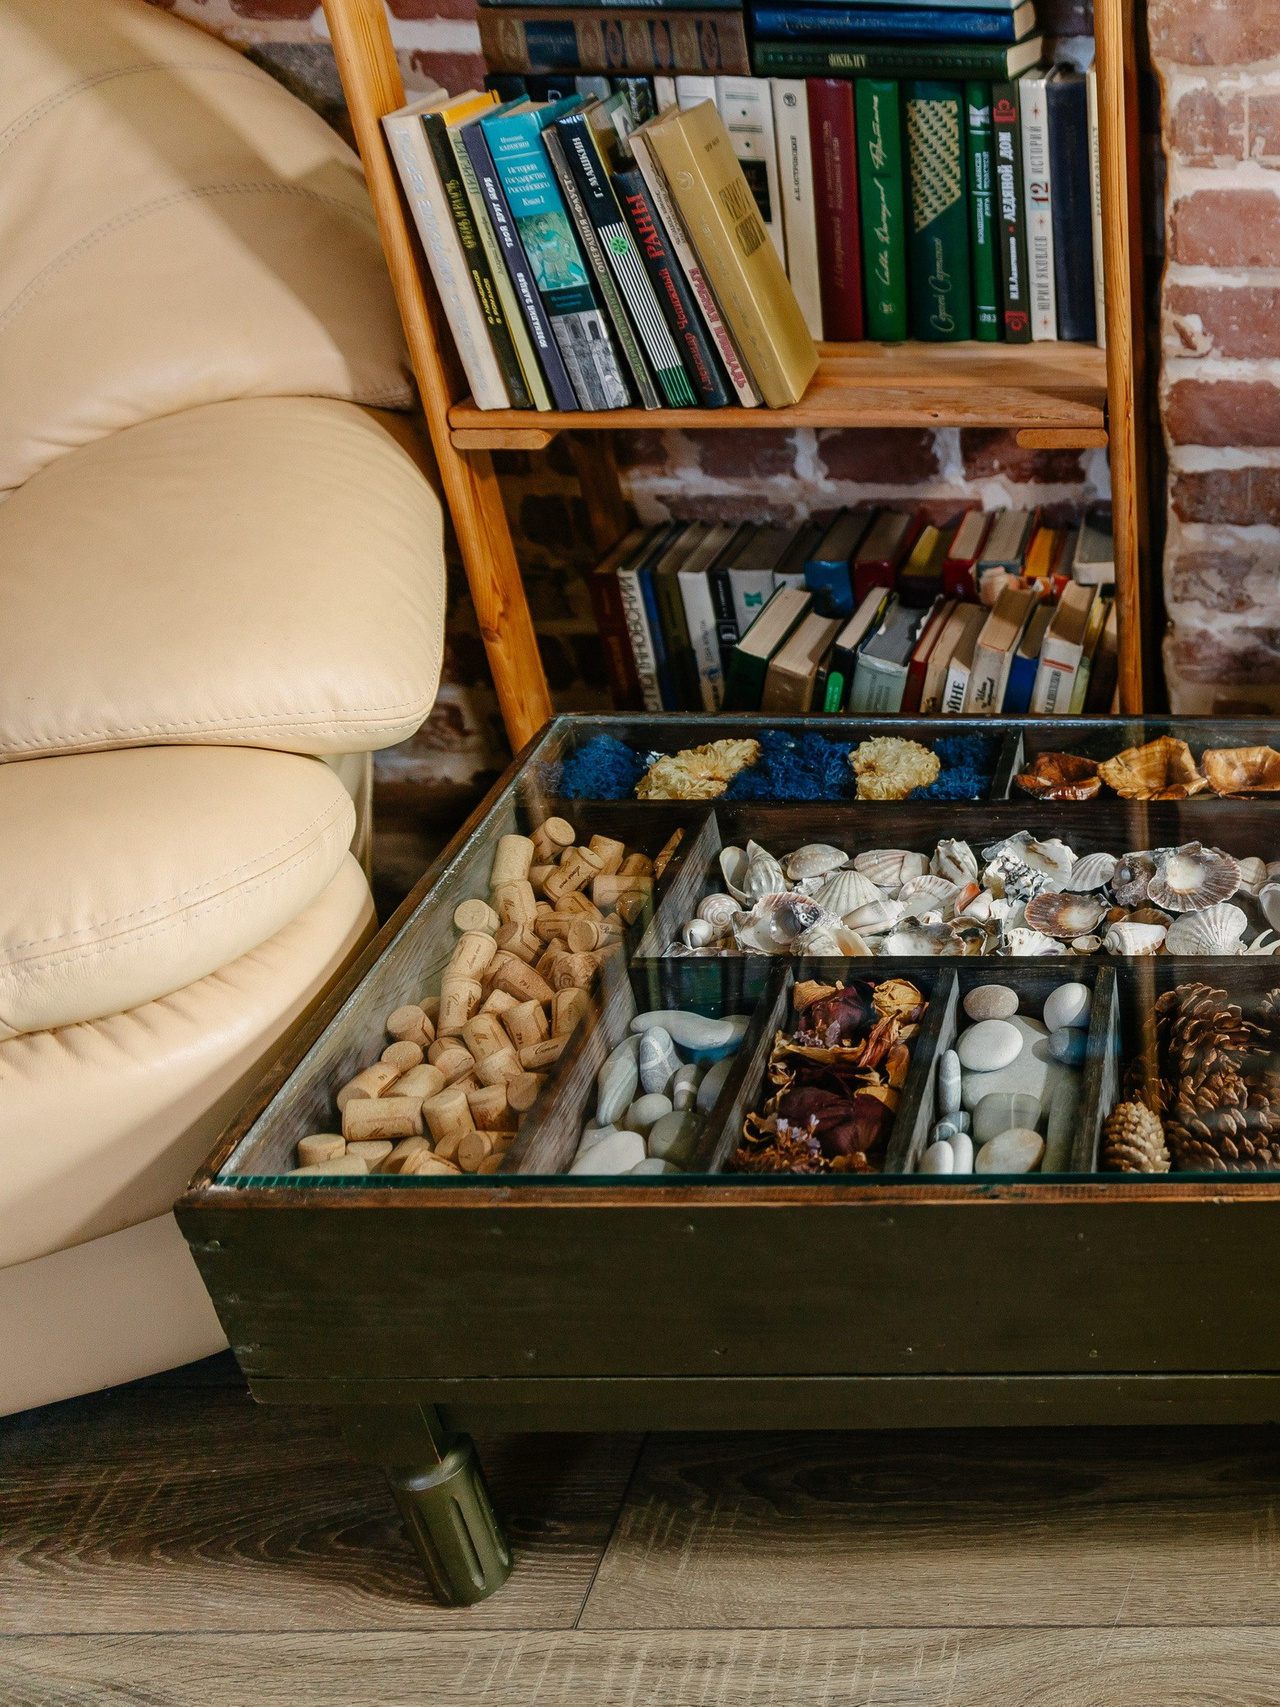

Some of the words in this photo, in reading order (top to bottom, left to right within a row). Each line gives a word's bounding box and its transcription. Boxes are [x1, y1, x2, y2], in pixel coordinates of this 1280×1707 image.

[570, 135, 600, 188] МАШКИН
[998, 131, 1013, 161] ДОМ
[1028, 125, 1044, 174] ИСТОРИЙ
[999, 164, 1016, 222] ЛЕДЯНОЙ
[1030, 181, 1049, 206] 12
[578, 217, 606, 274] ОПЕРАЦИЯ
[624, 190, 665, 261] РАНЫ
[1034, 235, 1049, 278] ЯКОВЛЕВ
[1034, 281, 1049, 310] ЮРИЙ
[681, 330, 715, 394] Александр
